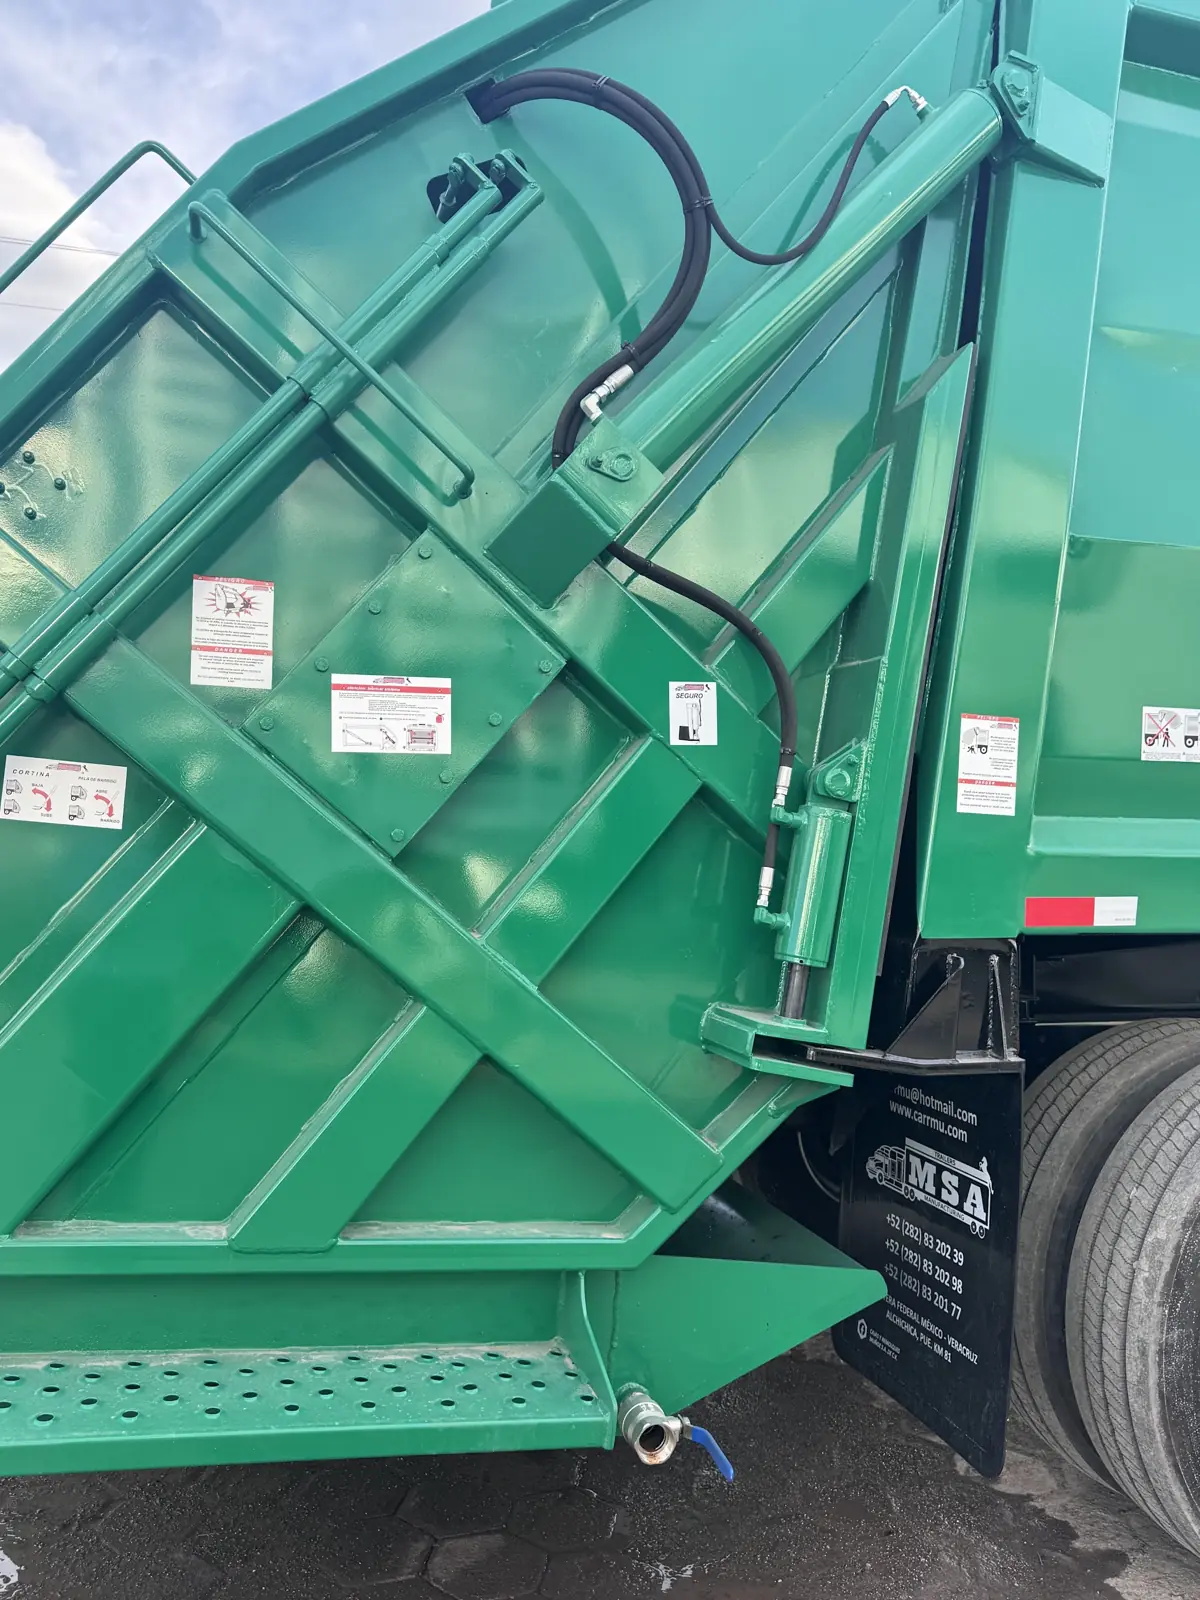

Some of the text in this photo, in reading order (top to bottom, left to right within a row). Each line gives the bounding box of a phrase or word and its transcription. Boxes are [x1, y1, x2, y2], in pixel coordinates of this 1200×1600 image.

[12, 769, 50, 778] CORTINA
[889, 1100, 967, 1143] www.carrmu.com
[934, 1151, 956, 1166] TRAILERS
[908, 1153, 987, 1222] MSA
[924, 1194, 965, 1221] MANUFACTURING
[886, 1213, 964, 1266] +52 (282) 83 202 39
[885, 1238, 963, 1294] +52 (282) 83 202 98
[884, 1263, 962, 1321] +52 (282) 83 201 77
[896, 1301, 920, 1324] FEDERAL
[920, 1317, 943, 1339] MÉXICO
[947, 1334, 978, 1365] VERACRUZ
[920, 1332, 932, 1349] PUE.
[933, 1342, 944, 1357] KM
[943, 1349, 952, 1363] 81
